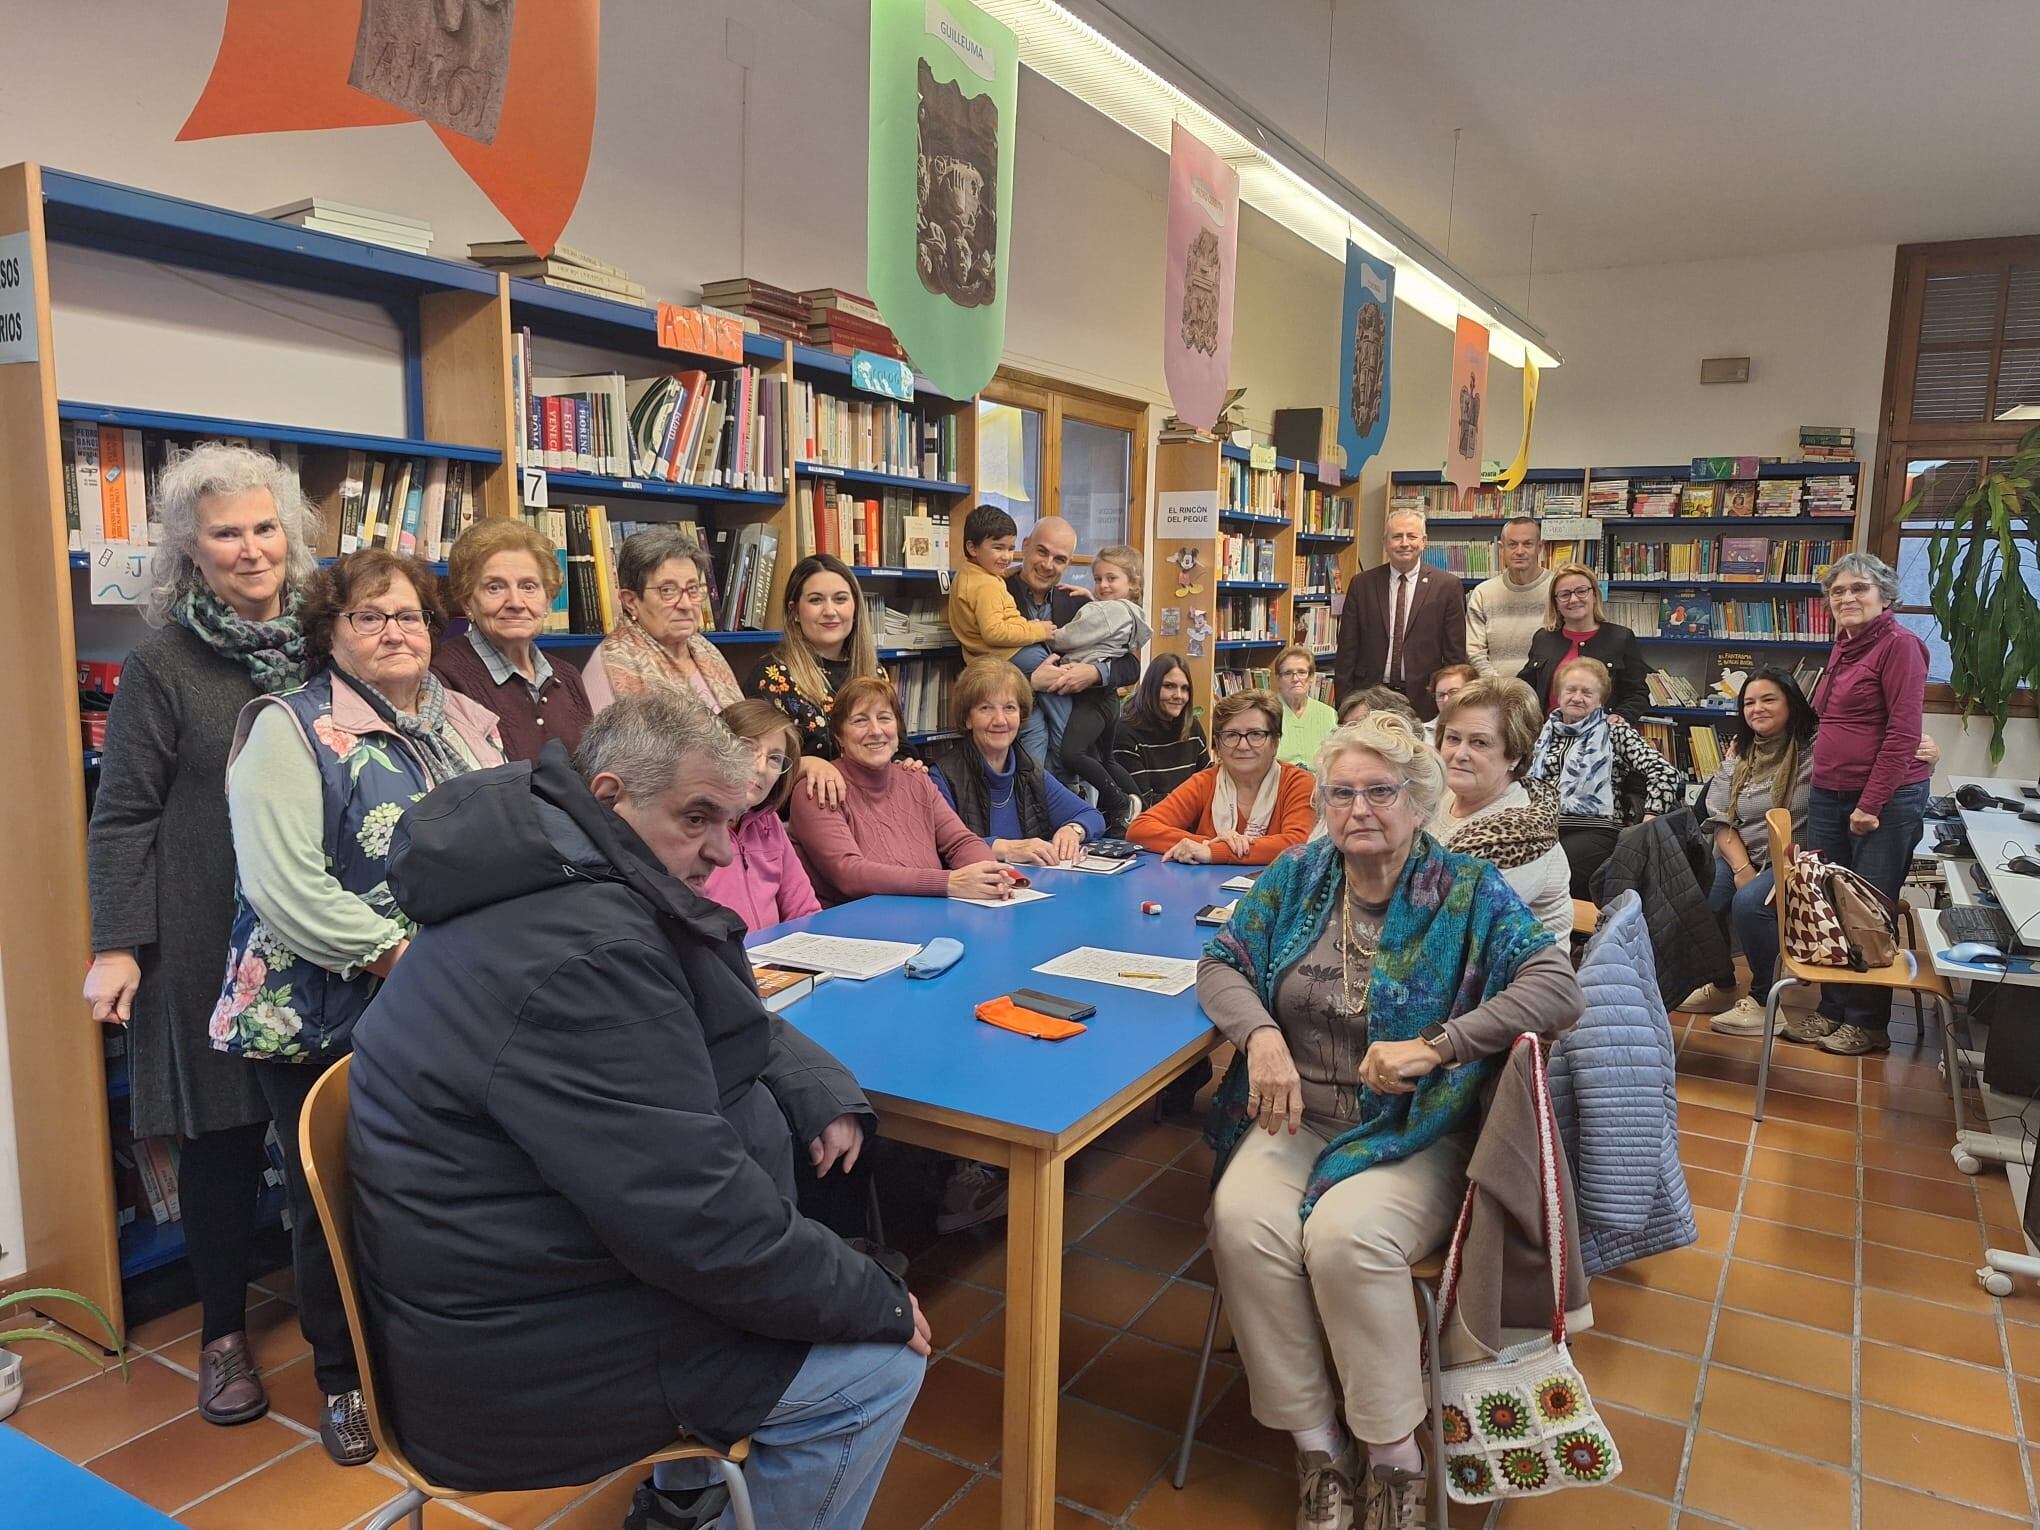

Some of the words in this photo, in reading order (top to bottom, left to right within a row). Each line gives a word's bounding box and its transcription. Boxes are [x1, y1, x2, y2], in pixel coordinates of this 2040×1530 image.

[940, 20, 985, 62] GUILLEUMA
[669, 411, 682, 440] Islam
[526, 473, 542, 501] 7
[1179, 505, 1208, 514] RINCÓN
[1167, 515, 1181, 523] DEL
[1183, 515, 1209, 523] PEQUE
[1724, 652, 1752, 660] FANTASMA
